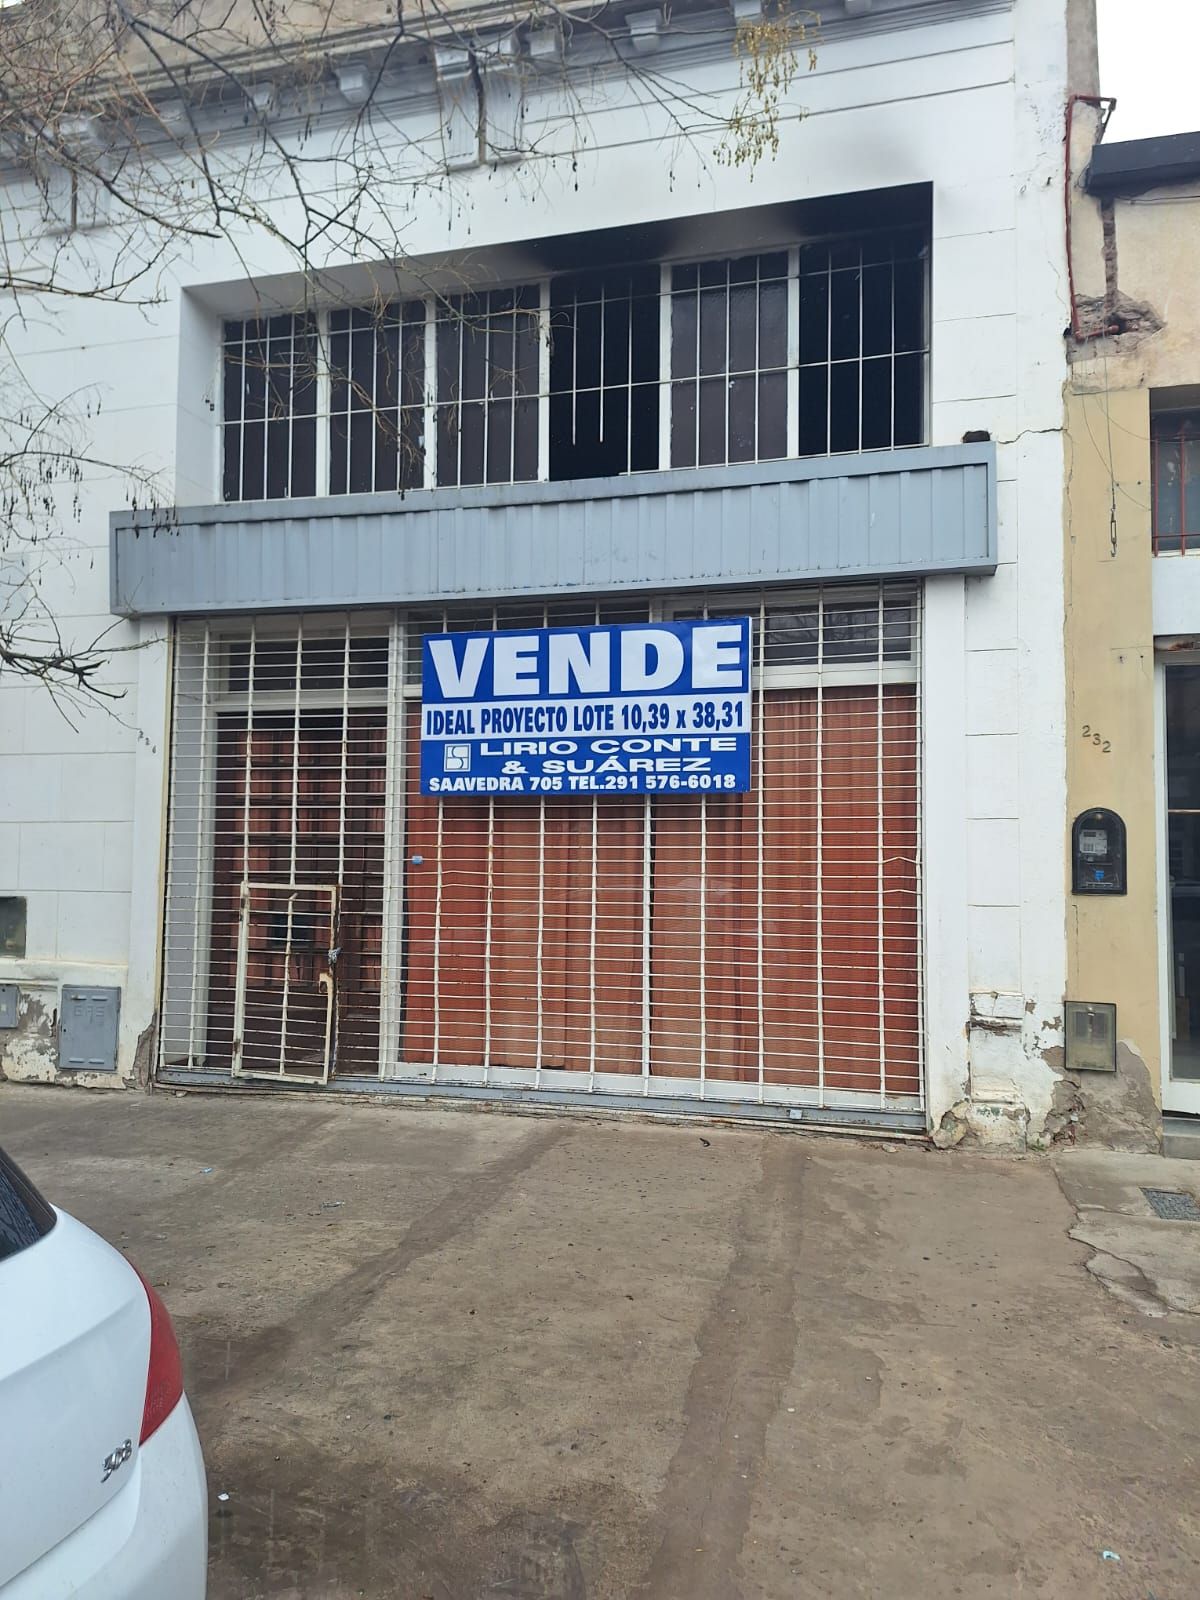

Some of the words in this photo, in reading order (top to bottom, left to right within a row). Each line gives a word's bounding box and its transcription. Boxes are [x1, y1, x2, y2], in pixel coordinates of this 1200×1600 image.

[428, 624, 743, 699] VENDE
[426, 709, 475, 736] IDEAL
[480, 705, 568, 734] PROYECTO
[573, 704, 614, 732] LOTE
[621, 702, 670, 733] 10,39
[676, 709, 687, 729] x
[692, 701, 743, 731] 38,31
[480, 740, 578, 756] LIRIO
[590, 737, 737, 754] CONTE
[1082, 725, 1111, 753] 232
[501, 760, 528, 774] &
[542, 755, 712, 774] SUÁREZ
[429, 776, 524, 792] SAAVEDRA
[529, 776, 562, 791] 705
[568, 775, 638, 790] TEL.291
[645, 774, 736, 789] 576-6018
